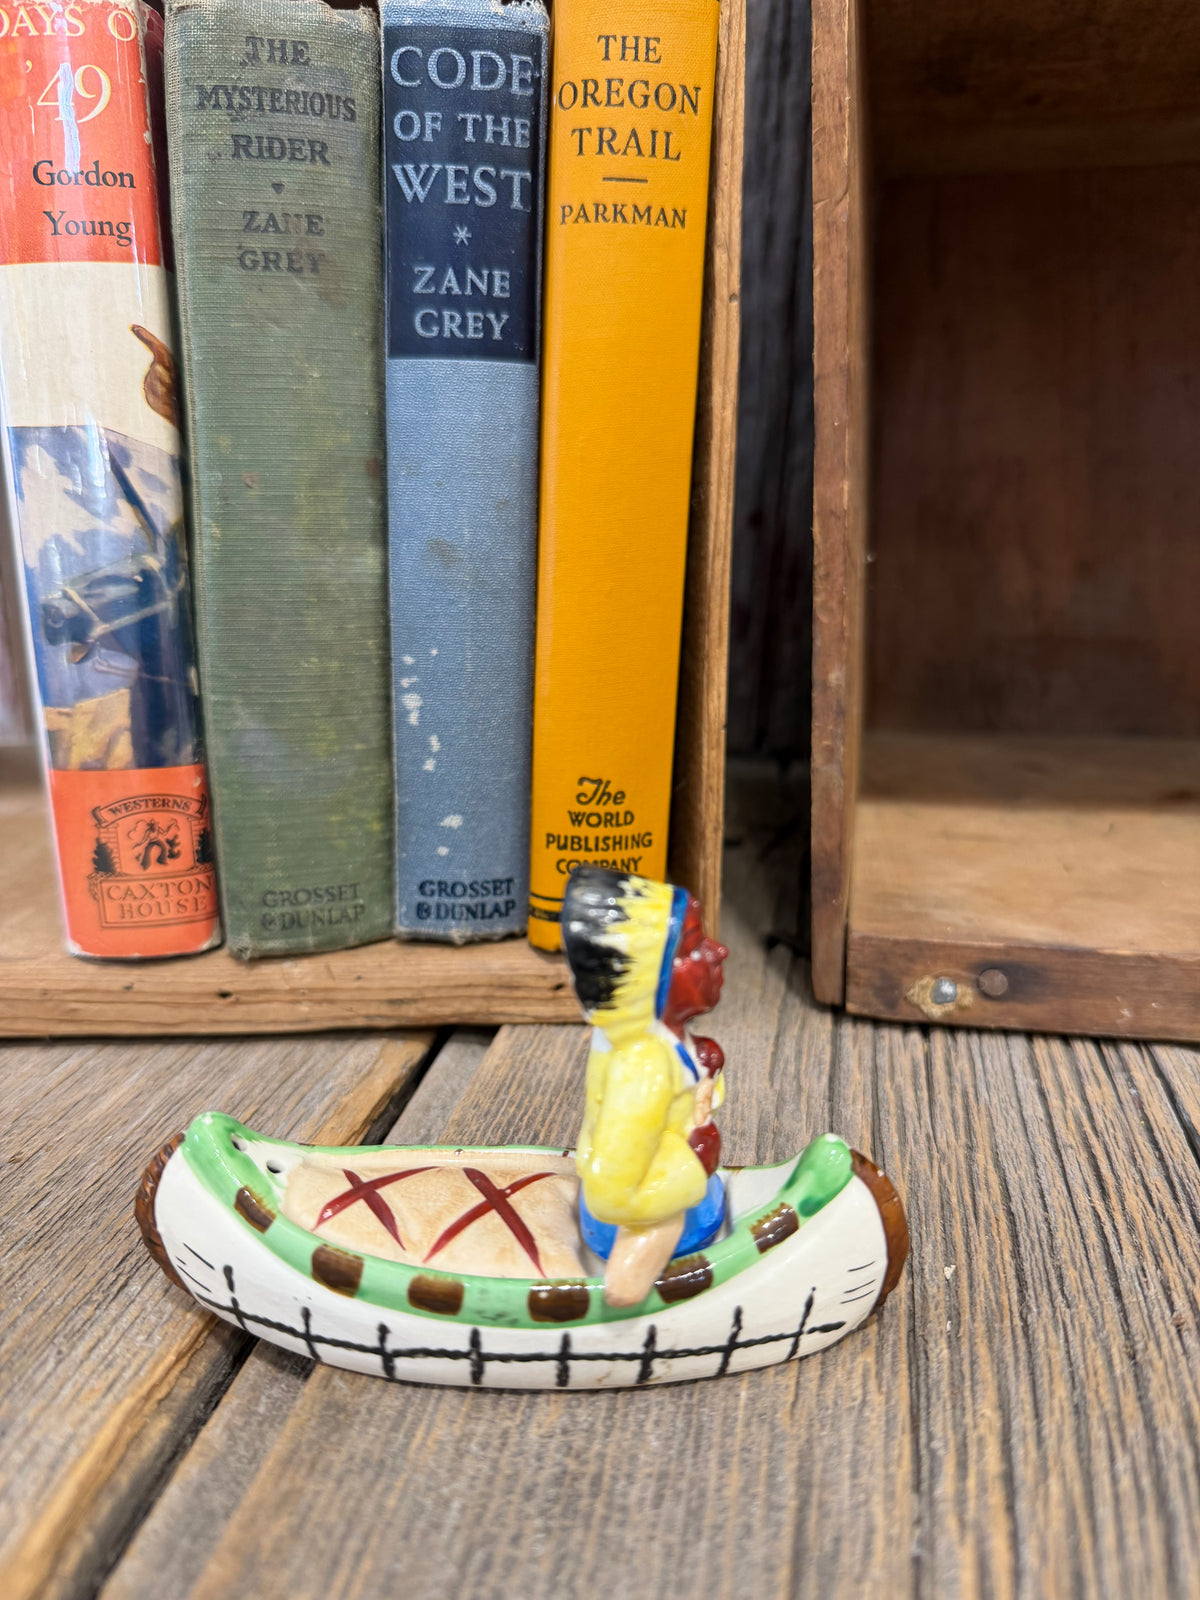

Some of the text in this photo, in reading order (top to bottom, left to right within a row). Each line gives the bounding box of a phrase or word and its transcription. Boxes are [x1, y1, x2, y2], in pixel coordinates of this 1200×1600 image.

[245, 35, 311, 67] THE
[597, 34, 663, 65] THE
[390, 45, 535, 96] CODE
[197, 84, 357, 123] MYSTERIOUS
[558, 78, 702, 117] OREGON
[393, 110, 531, 149] OF THE
[570, 127, 682, 162] TRAIL
[231, 134, 331, 166] RIDER
[33, 159, 136, 189] Gordon
[392, 163, 533, 213] WEST
[43, 210, 133, 247] Young
[242, 210, 325, 237] ZANE
[559, 203, 688, 230] PARKMAN
[237, 248, 325, 274] GREY
[412, 266, 511, 299] ZANE
[413, 308, 510, 341] GREY
[575, 776, 627, 806] The
[108, 798, 193, 817] WESTERNS
[567, 810, 635, 829] WORLD
[545, 832, 653, 853] PUBLISHING
[555, 855, 643, 876] COPANY
[106, 874, 213, 902] CAXTON
[261, 883, 361, 909] GROSSET
[418, 877, 514, 898] GROSSET
[119, 894, 208, 920] HOUSE
